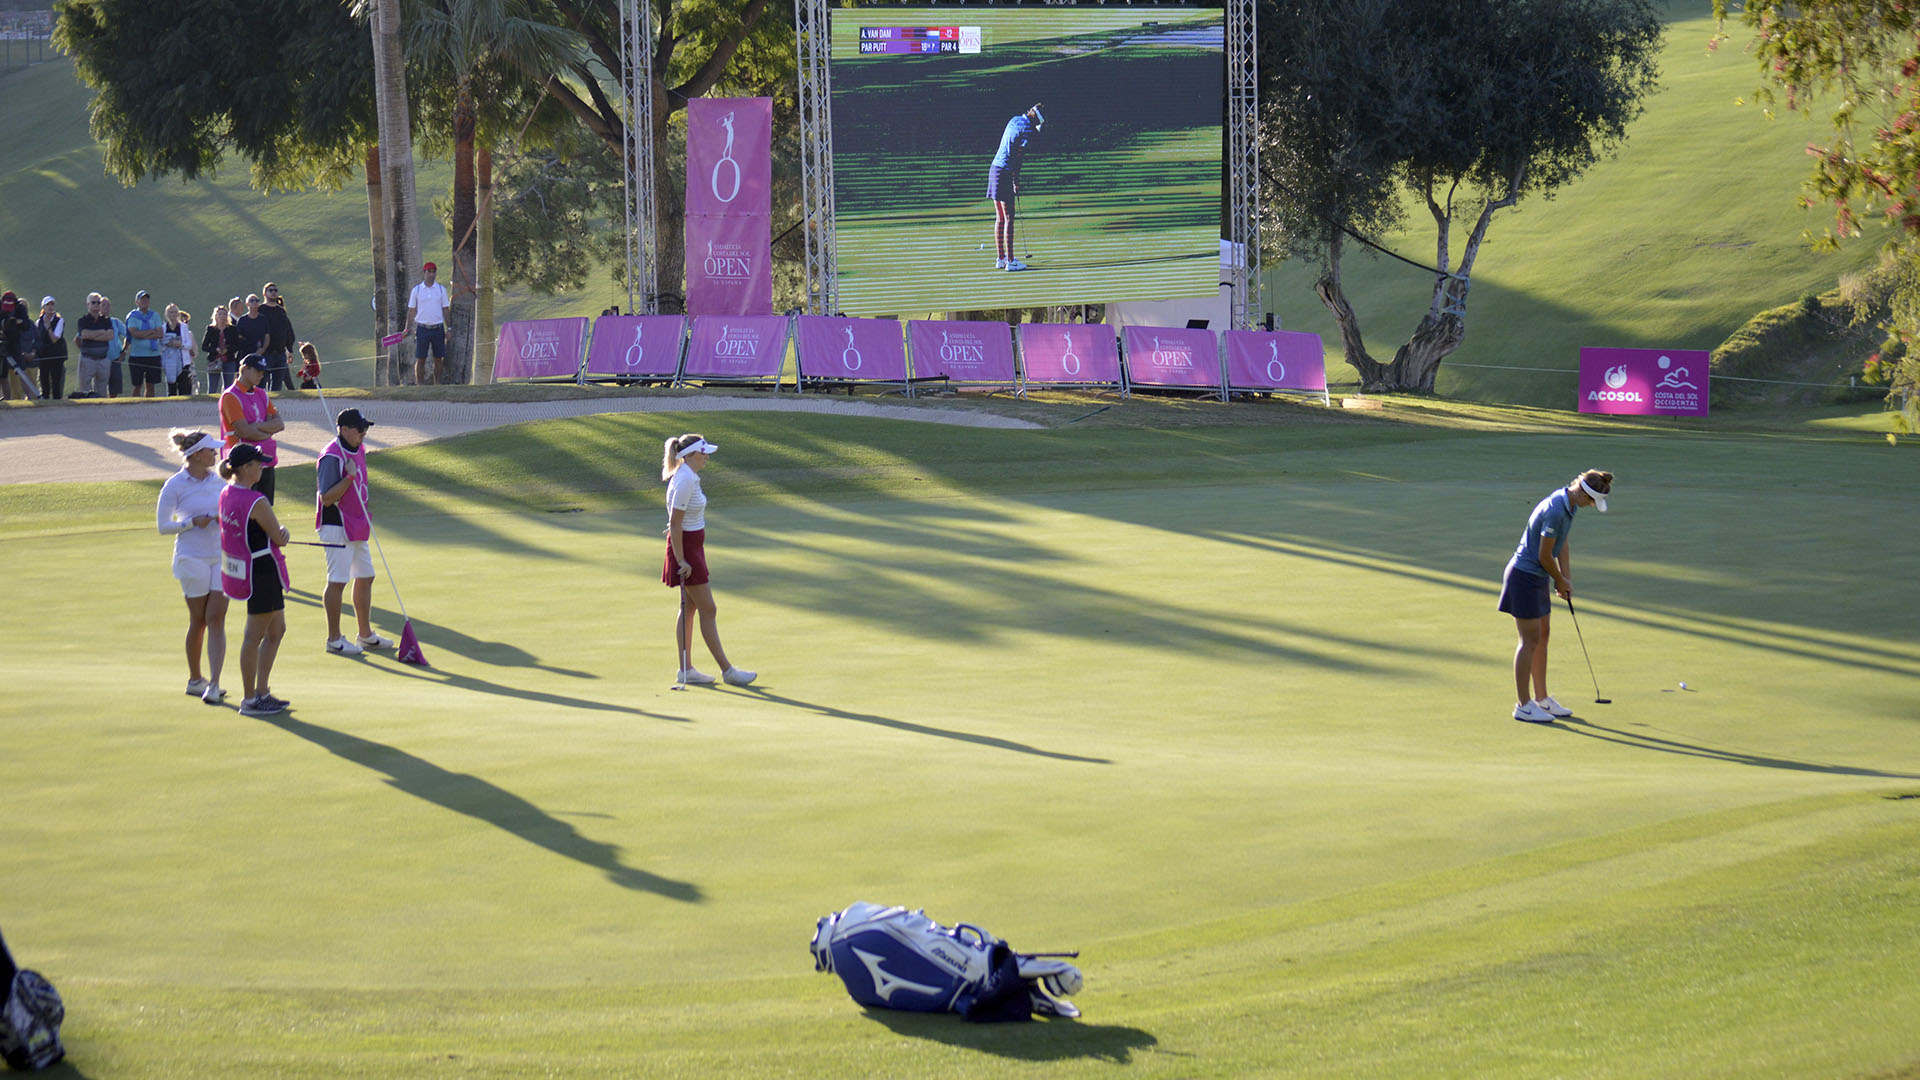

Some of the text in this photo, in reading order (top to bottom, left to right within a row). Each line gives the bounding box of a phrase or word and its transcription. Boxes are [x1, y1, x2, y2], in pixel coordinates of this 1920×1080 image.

[866, 30, 878, 38] VAN
[880, 30, 892, 38] DAM
[861, 43, 887, 51] PAR PUTT
[941, 42, 957, 51] PAR 4
[704, 256, 751, 276] OPEN
[521, 342, 560, 359] OPEN
[716, 339, 759, 356] OPEN
[940, 345, 983, 361] OPEN
[1152, 351, 1192, 366] OPEN
[1588, 391, 1643, 402] ACOSOL
